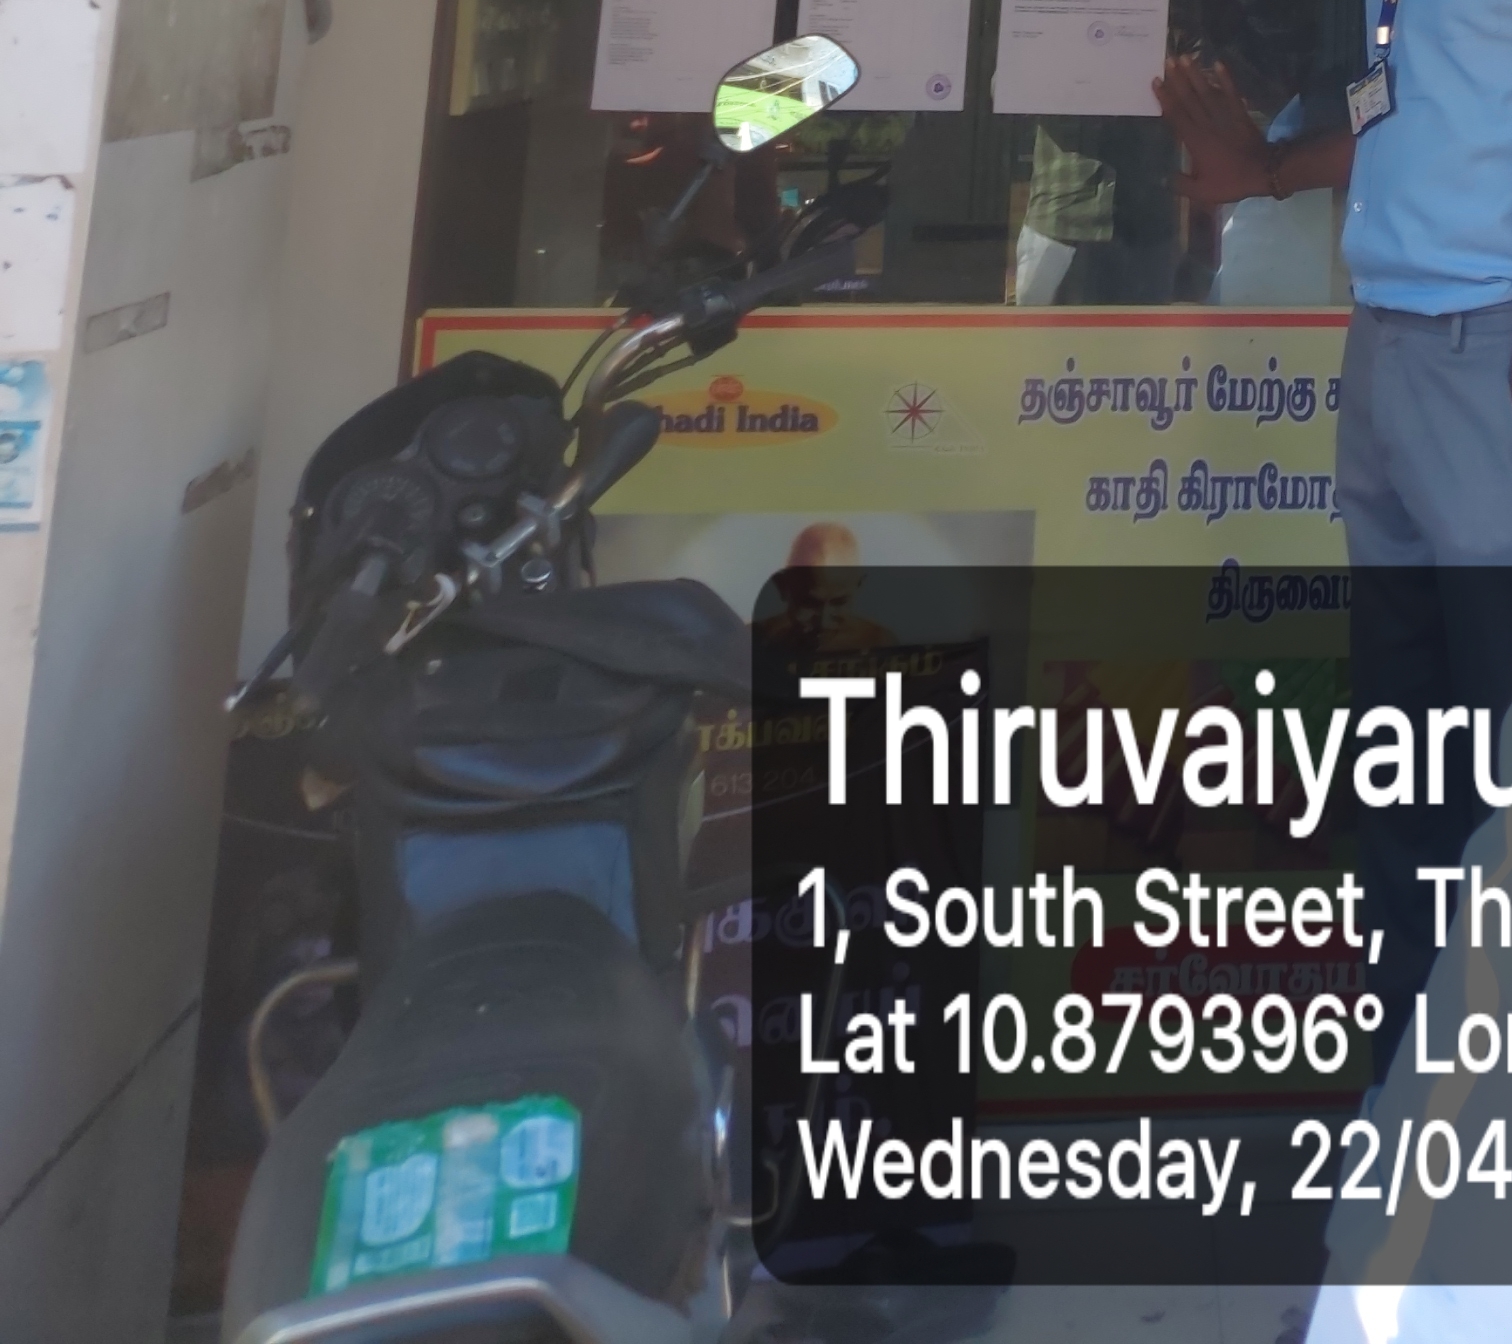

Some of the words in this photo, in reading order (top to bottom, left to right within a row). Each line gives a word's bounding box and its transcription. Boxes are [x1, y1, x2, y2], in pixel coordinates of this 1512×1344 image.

[655, 404, 725, 433] hadi
[735, 403, 819, 433] India
[1085, 457, 1170, 525] காதி
